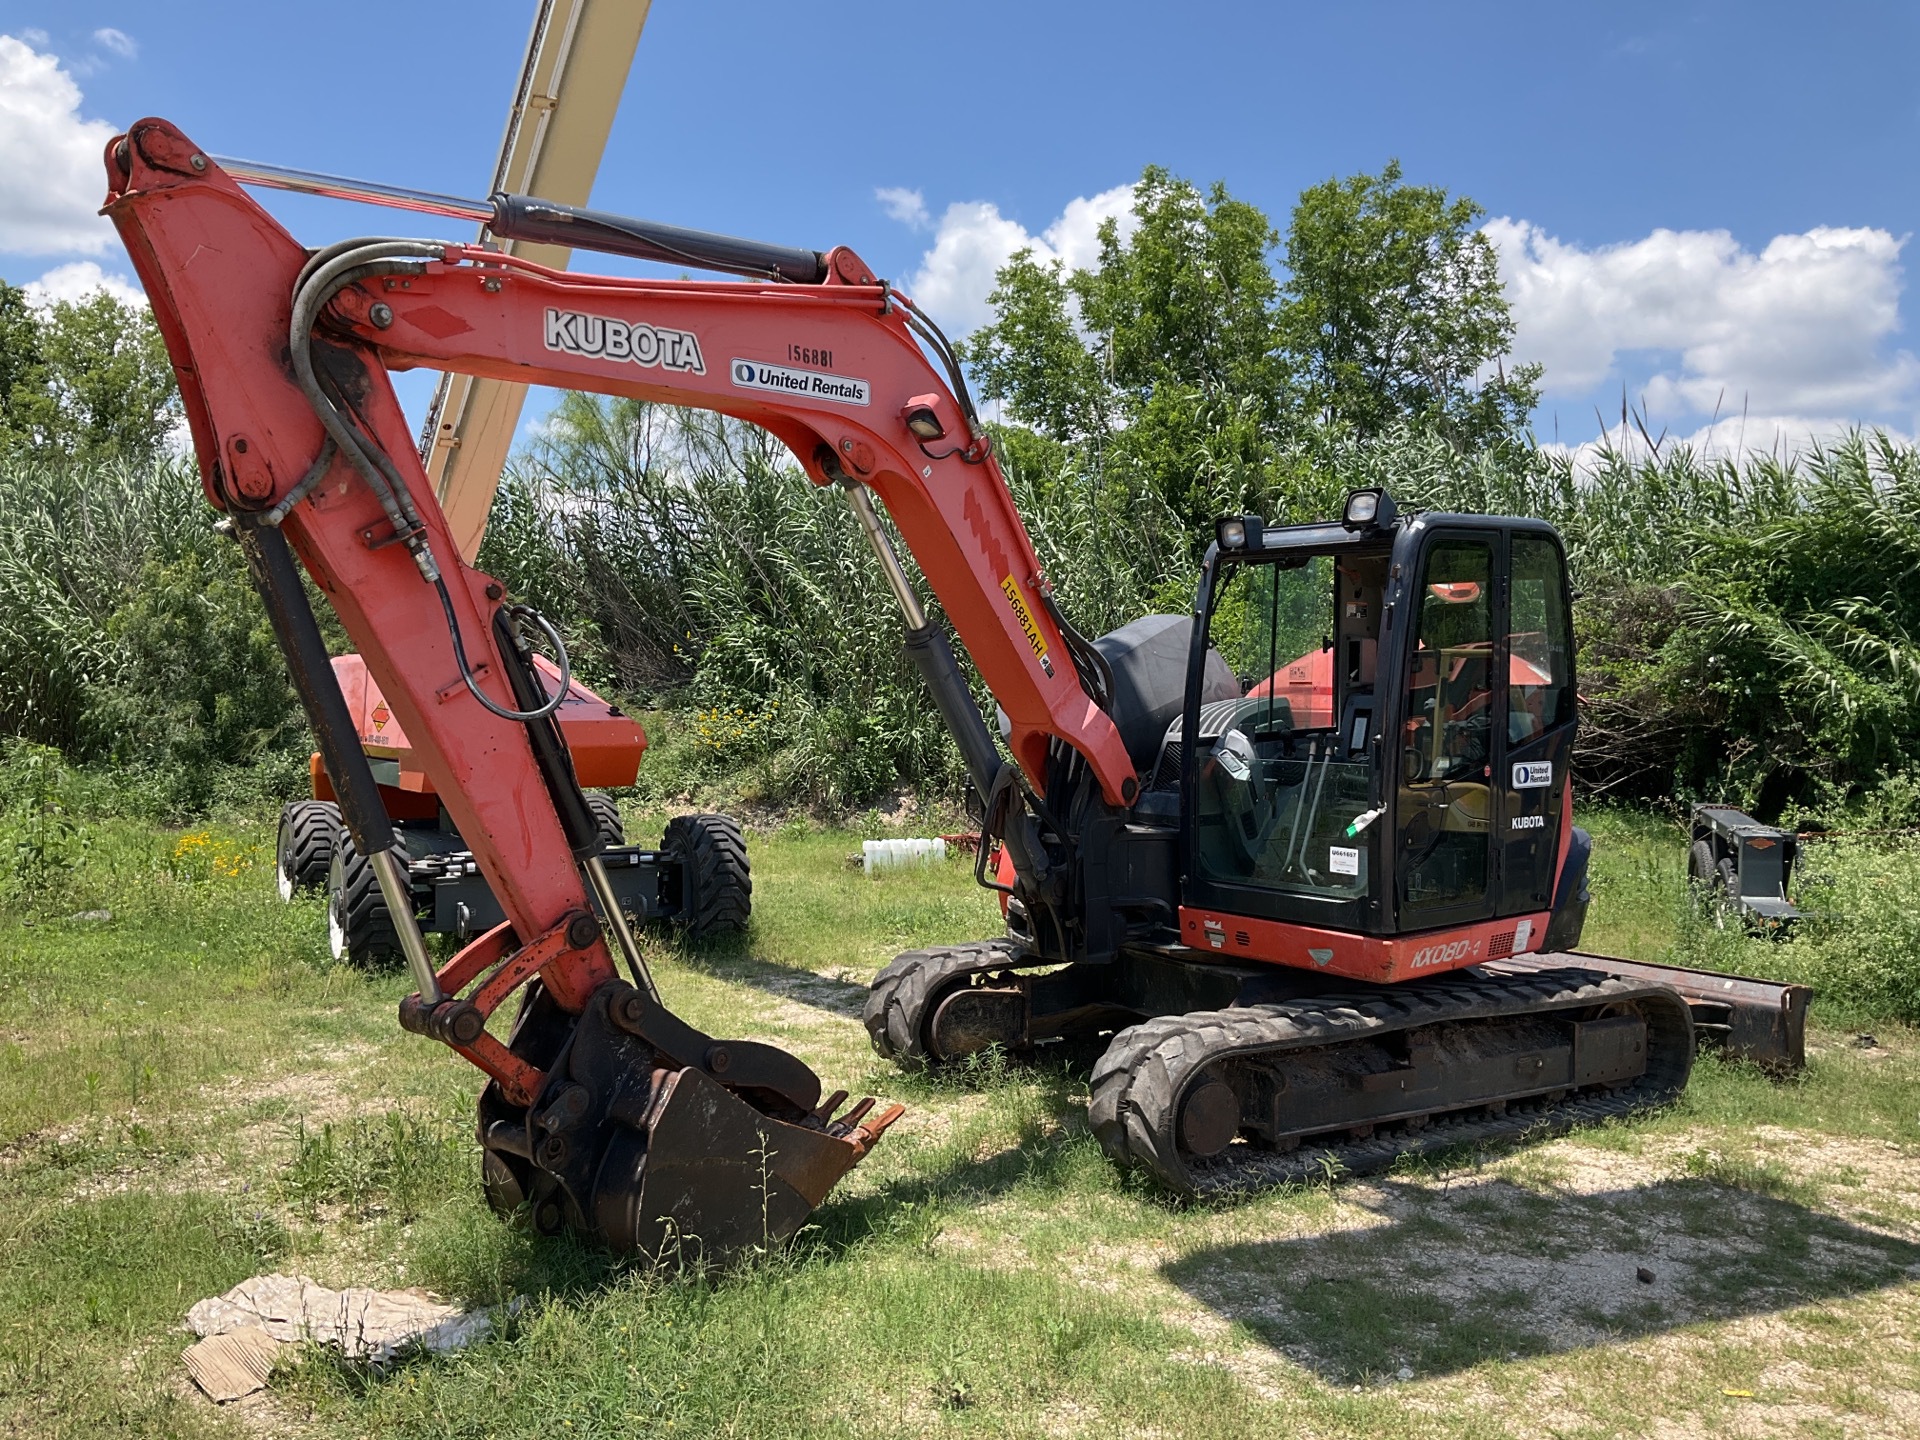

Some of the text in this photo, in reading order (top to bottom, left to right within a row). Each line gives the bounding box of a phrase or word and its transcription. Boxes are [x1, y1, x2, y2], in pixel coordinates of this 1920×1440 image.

[545, 308, 706, 374] KUBOTA
[787, 343, 833, 368] 156881
[759, 368, 864, 401] United Rentals
[1002, 581, 1043, 656] 156881AH
[1529, 774, 1550, 783] Rentals
[1530, 766, 1549, 774] United
[1511, 815, 1544, 830] KUBOTA
